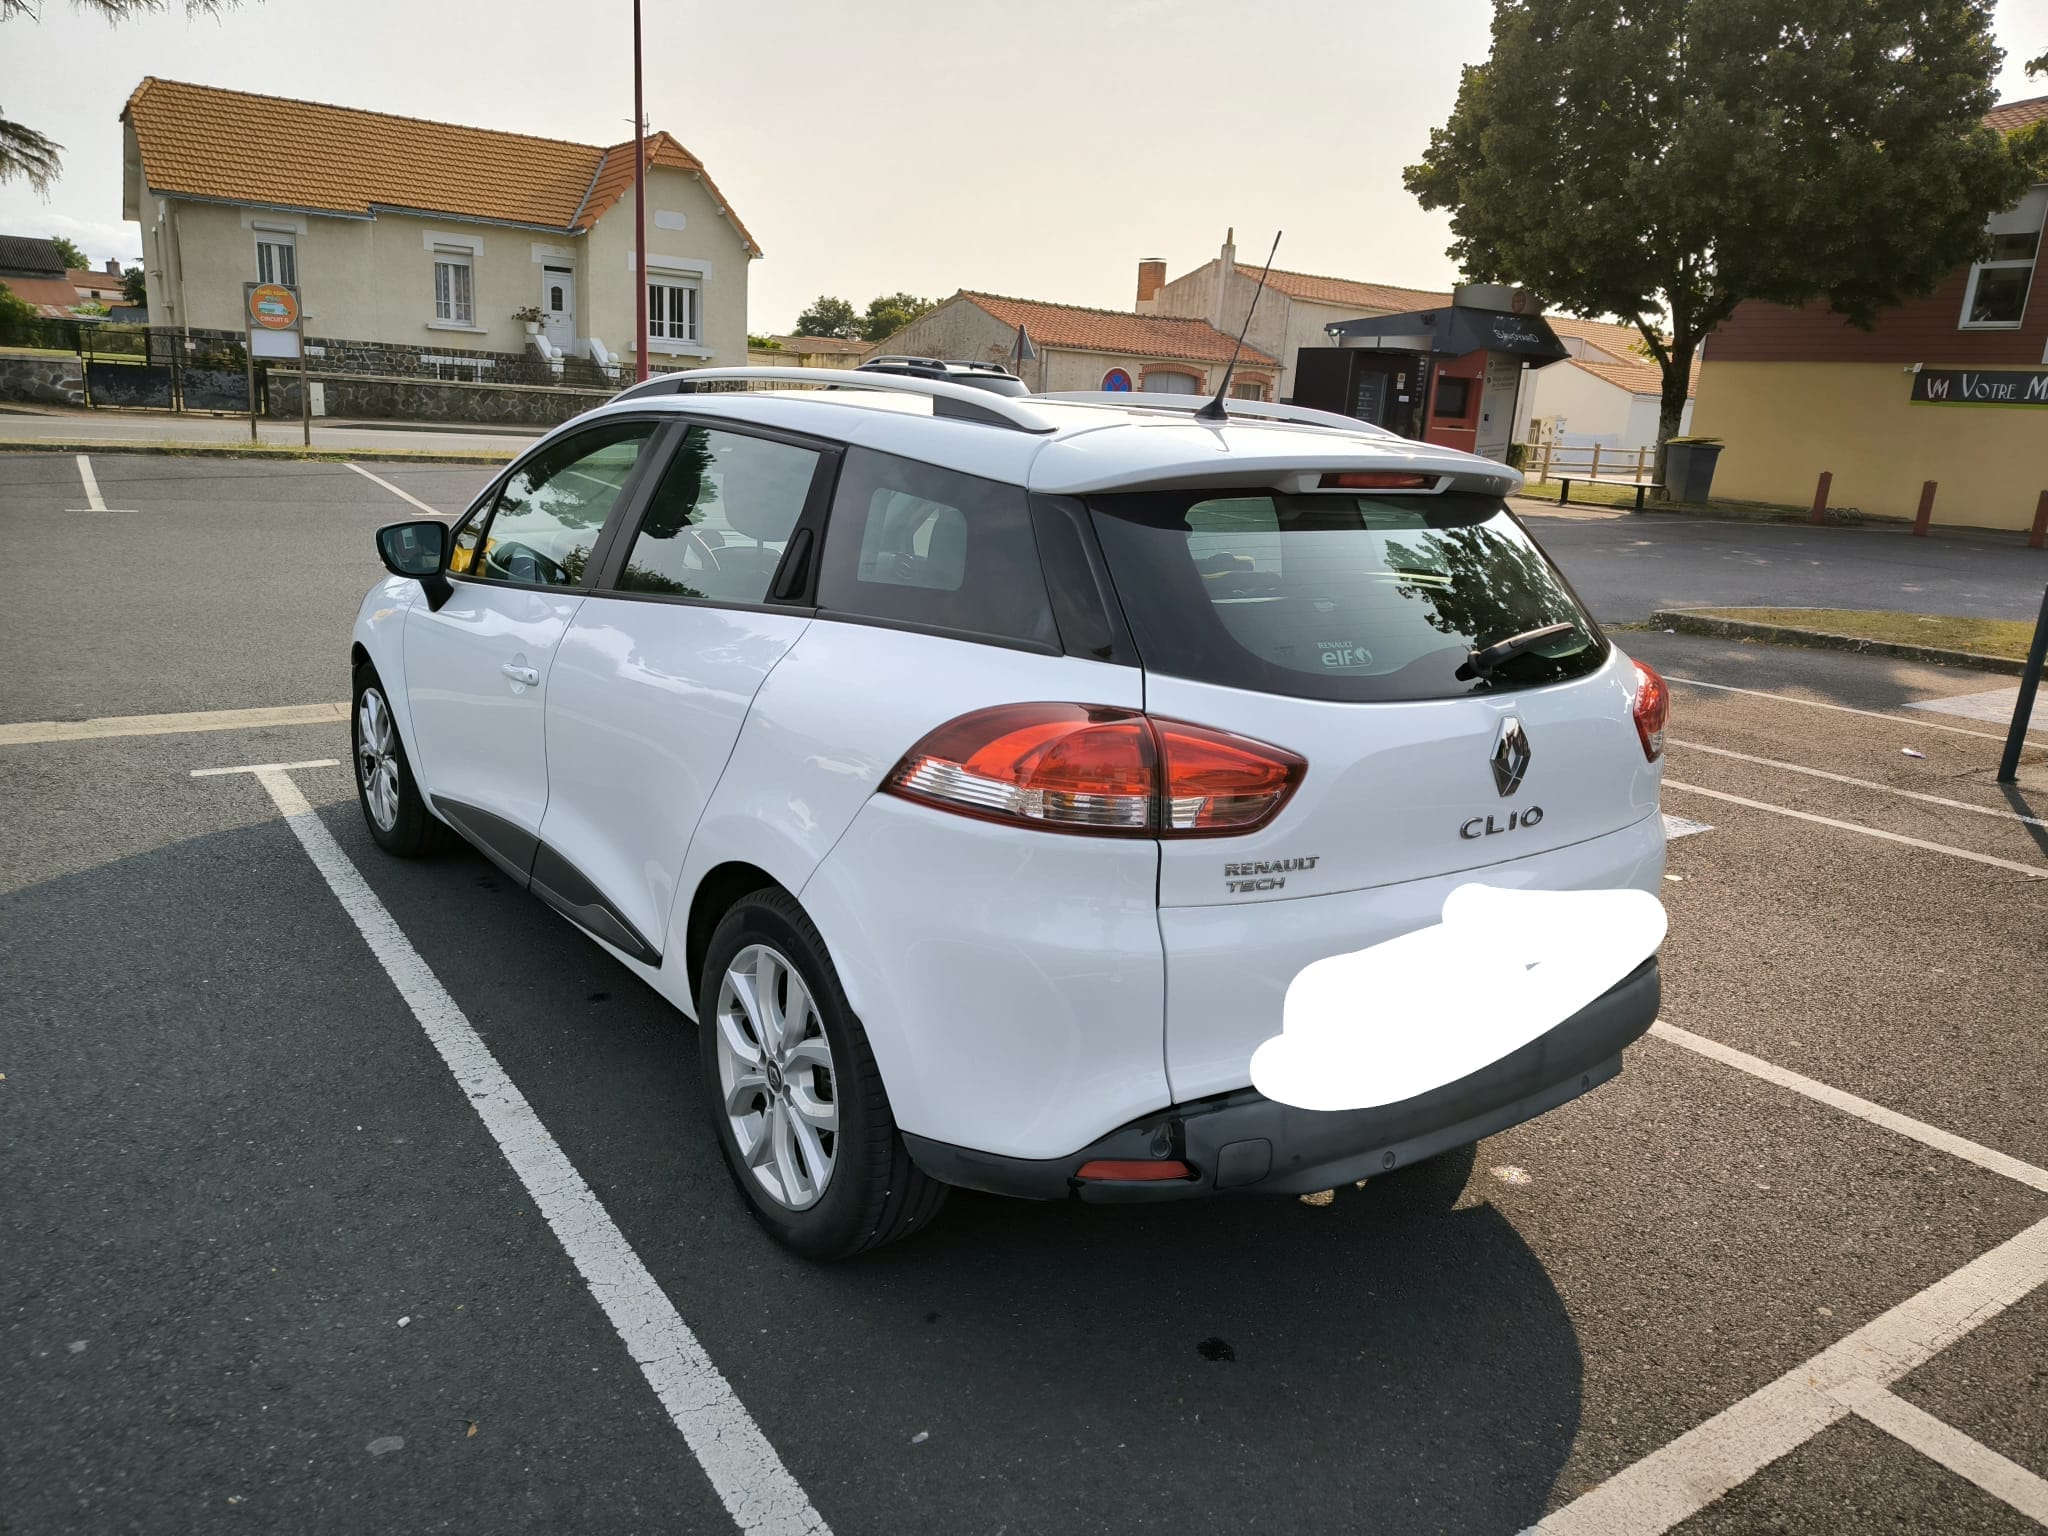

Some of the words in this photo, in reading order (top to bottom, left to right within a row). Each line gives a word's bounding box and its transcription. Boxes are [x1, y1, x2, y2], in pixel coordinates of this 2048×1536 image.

[260, 315, 283, 323] CIRCUIT
[2024, 376, 2048, 399] M
[1317, 641, 1352, 649] RENAULT
[1460, 806, 1543, 839] CLIO
[1225, 857, 1320, 876] RENAULT
[1226, 877, 1285, 893] TECH
